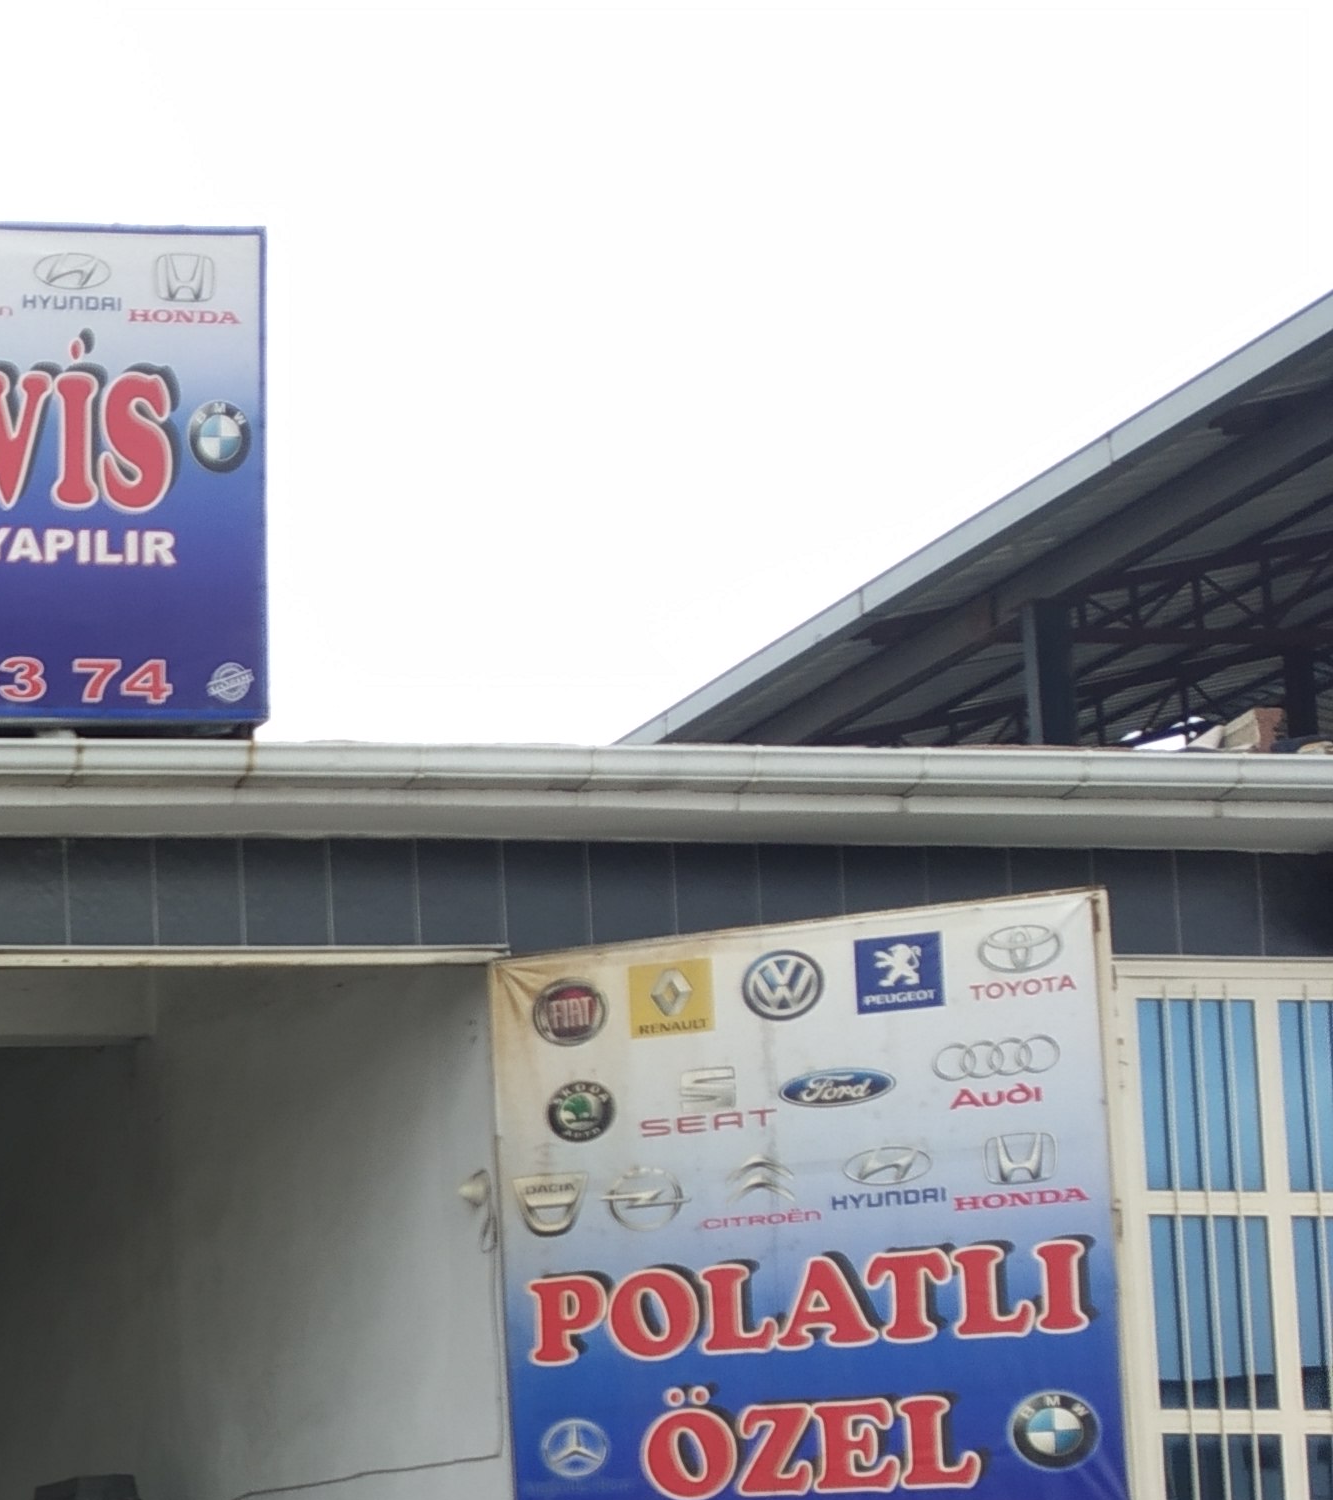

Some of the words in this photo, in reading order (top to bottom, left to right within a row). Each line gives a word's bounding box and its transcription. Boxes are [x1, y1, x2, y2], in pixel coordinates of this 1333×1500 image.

[23, 294, 123, 312] HYUNDAI
[128, 309, 240, 325] HONDA
[72, 657, 173, 705] 74
[863, 989, 936, 1007] PEUGEOT
[970, 974, 1076, 1000] TOYOTA
[548, 996, 594, 1027] FIAT
[638, 1018, 709, 1036] RENAULT
[802, 1073, 871, 1103] Ford
[640, 1108, 777, 1137] SEAT
[524, 1182, 575, 1196] DACIA
[832, 1187, 947, 1211] HYUNDAI
[954, 1188, 1090, 1212] HONDA
[529, 1238, 1093, 1367] POLATLI
[1020, 1395, 1089, 1418] BMW
